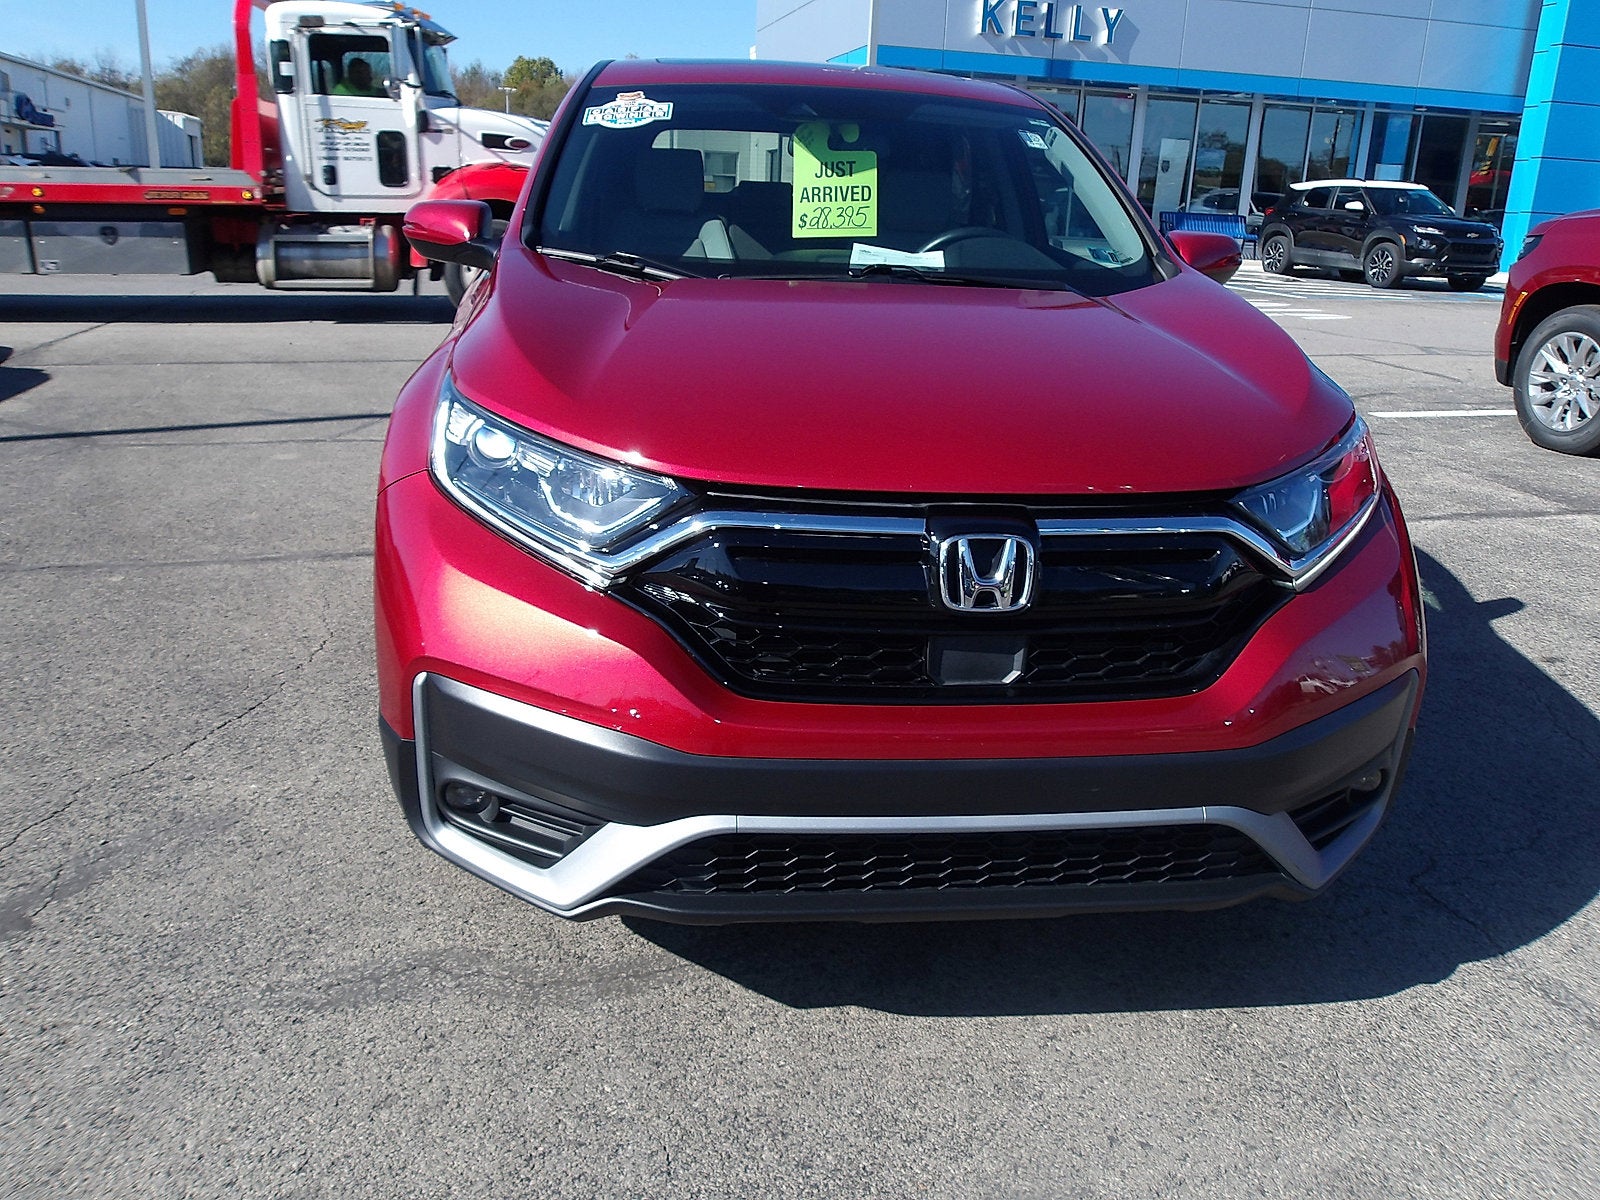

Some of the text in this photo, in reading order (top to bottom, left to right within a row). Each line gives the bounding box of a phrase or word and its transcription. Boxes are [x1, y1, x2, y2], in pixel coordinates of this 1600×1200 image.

[981, 0, 1124, 44] KELLY
[815, 161, 856, 179] JUST
[800, 185, 872, 203] ARRIVED
